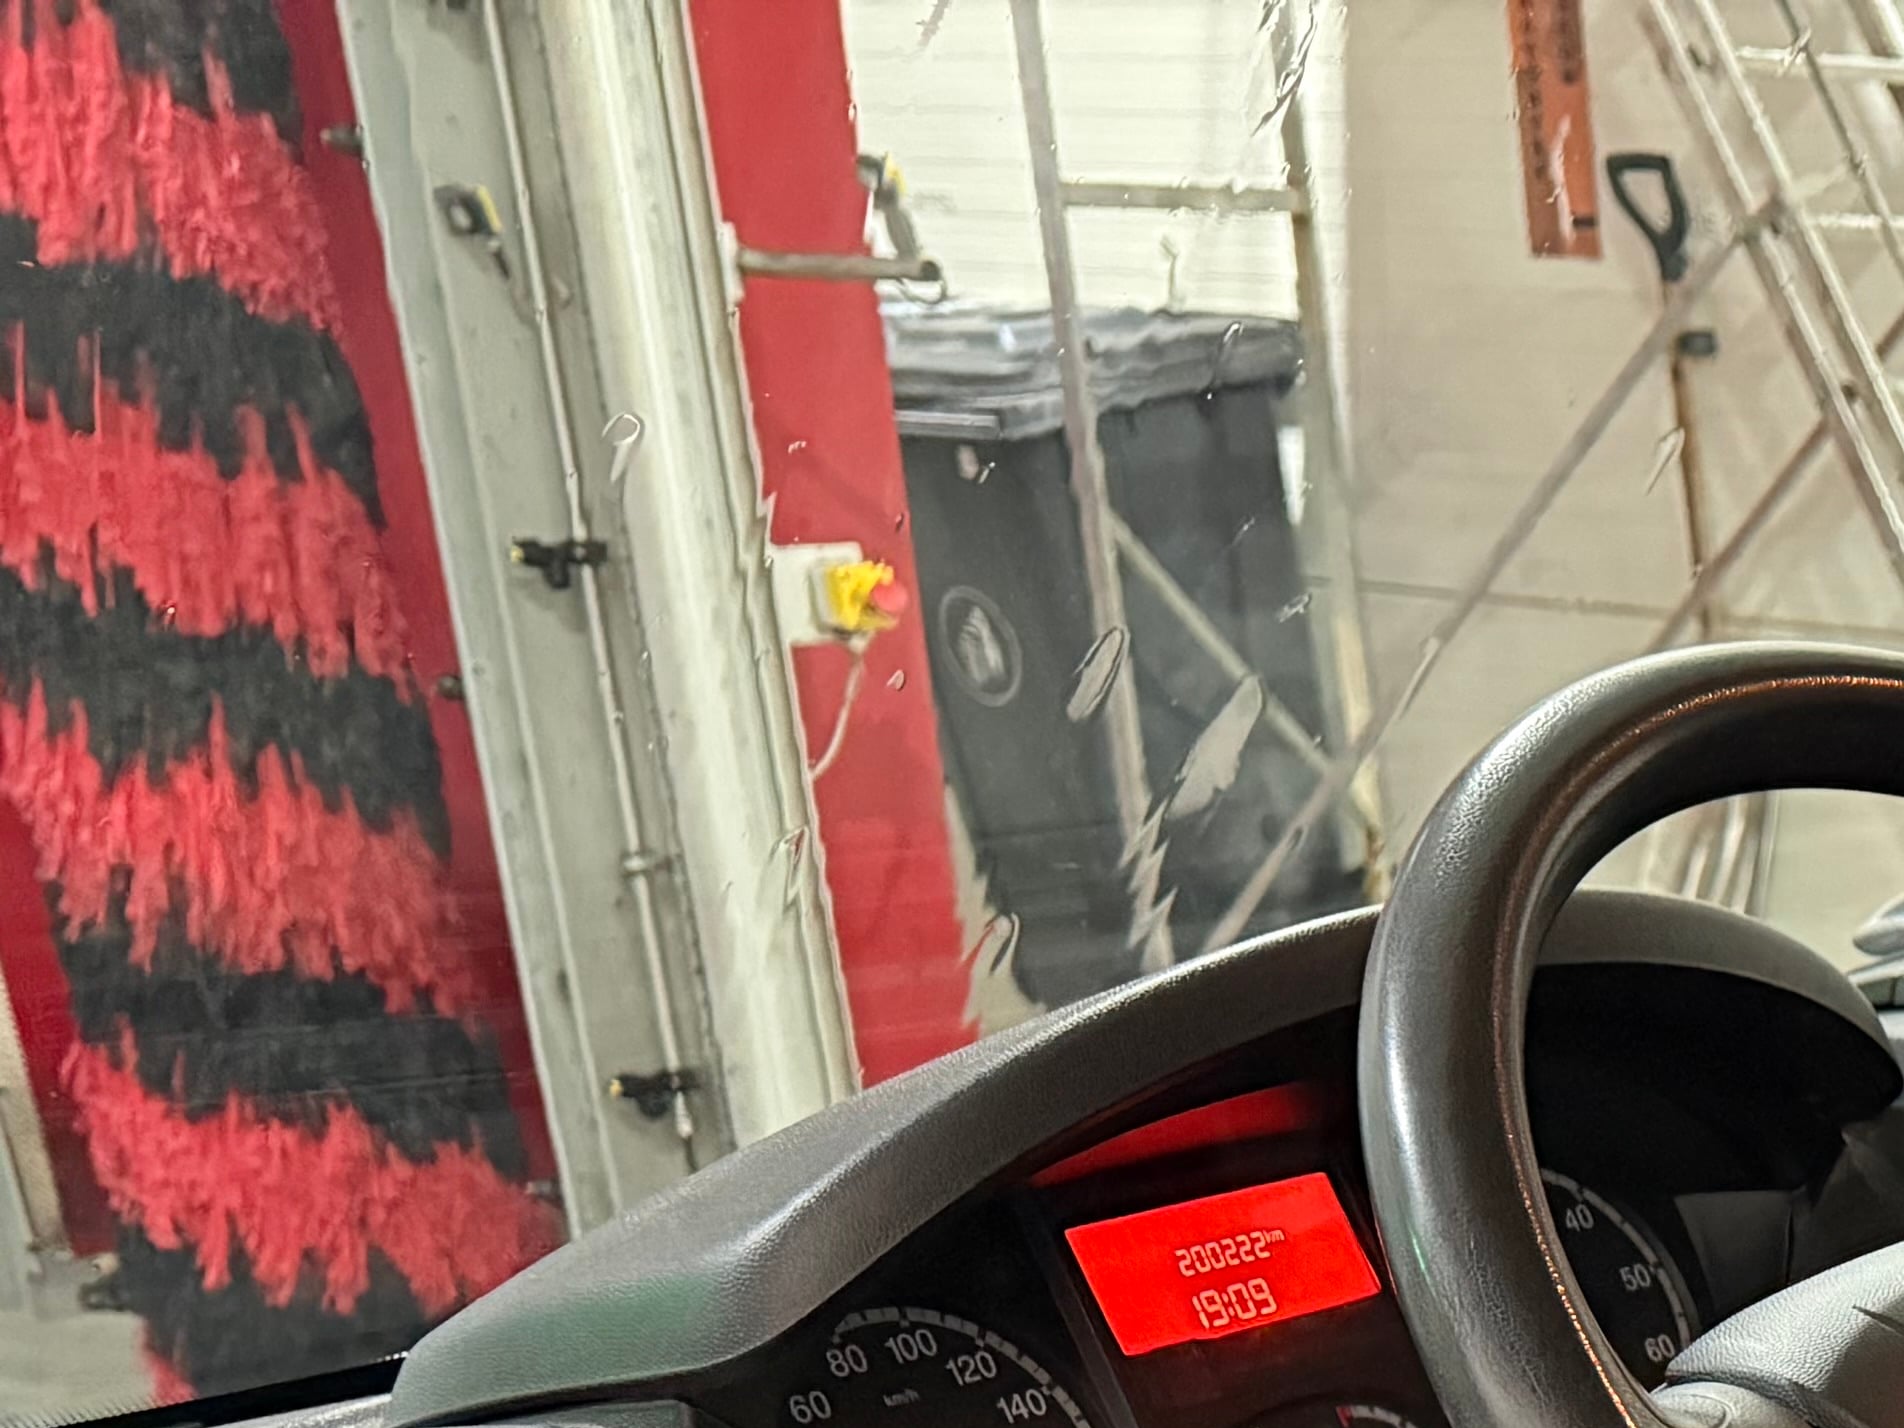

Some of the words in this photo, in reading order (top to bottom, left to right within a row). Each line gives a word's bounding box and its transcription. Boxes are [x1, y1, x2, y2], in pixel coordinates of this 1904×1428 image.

[1565, 1204, 1594, 1231] 40
[1175, 1231, 1271, 1277] 200222
[1619, 1263, 1650, 1291] 50
[1192, 1278, 1277, 1329] 19:09
[826, 1345, 868, 1377] 80
[884, 1329, 938, 1363] 100
[1644, 1334, 1675, 1362] 60
[945, 1350, 997, 1386] 120
[789, 1391, 832, 1424] 60
[996, 1388, 1047, 1424] 140
